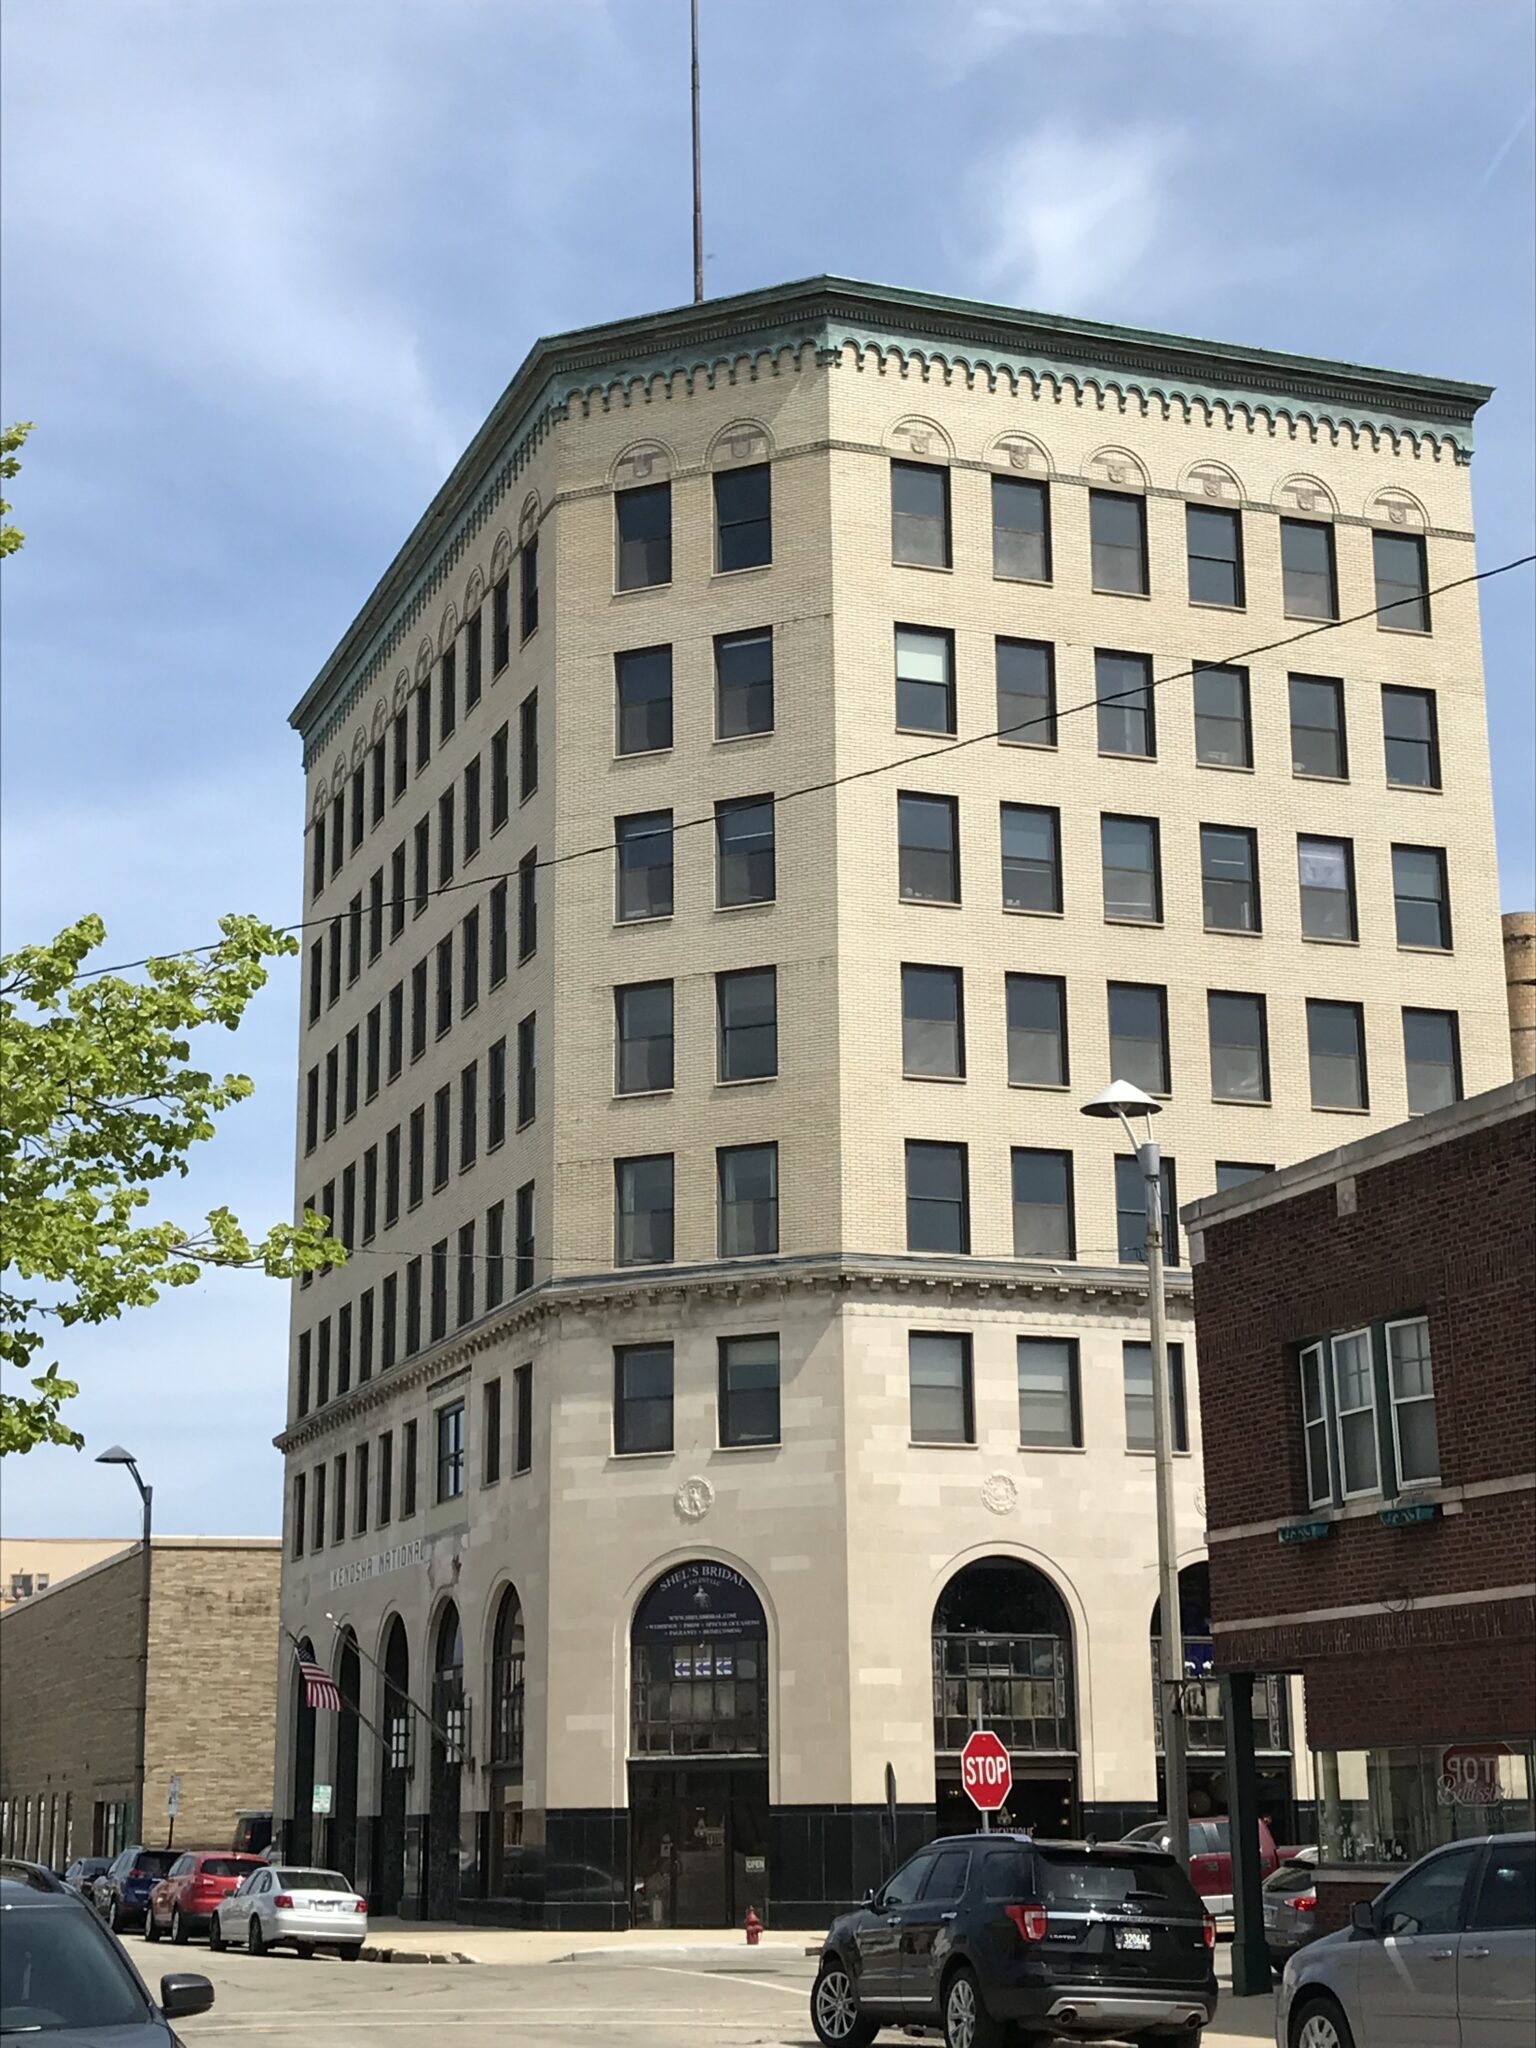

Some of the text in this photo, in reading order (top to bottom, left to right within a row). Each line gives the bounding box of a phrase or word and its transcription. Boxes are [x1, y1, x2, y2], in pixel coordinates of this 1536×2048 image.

[333, 1541, 423, 1588] KENOSHA NATIONAL
[660, 1566, 746, 1592] SHEL'S BRIDAL
[966, 1756, 1007, 1785] STOP
